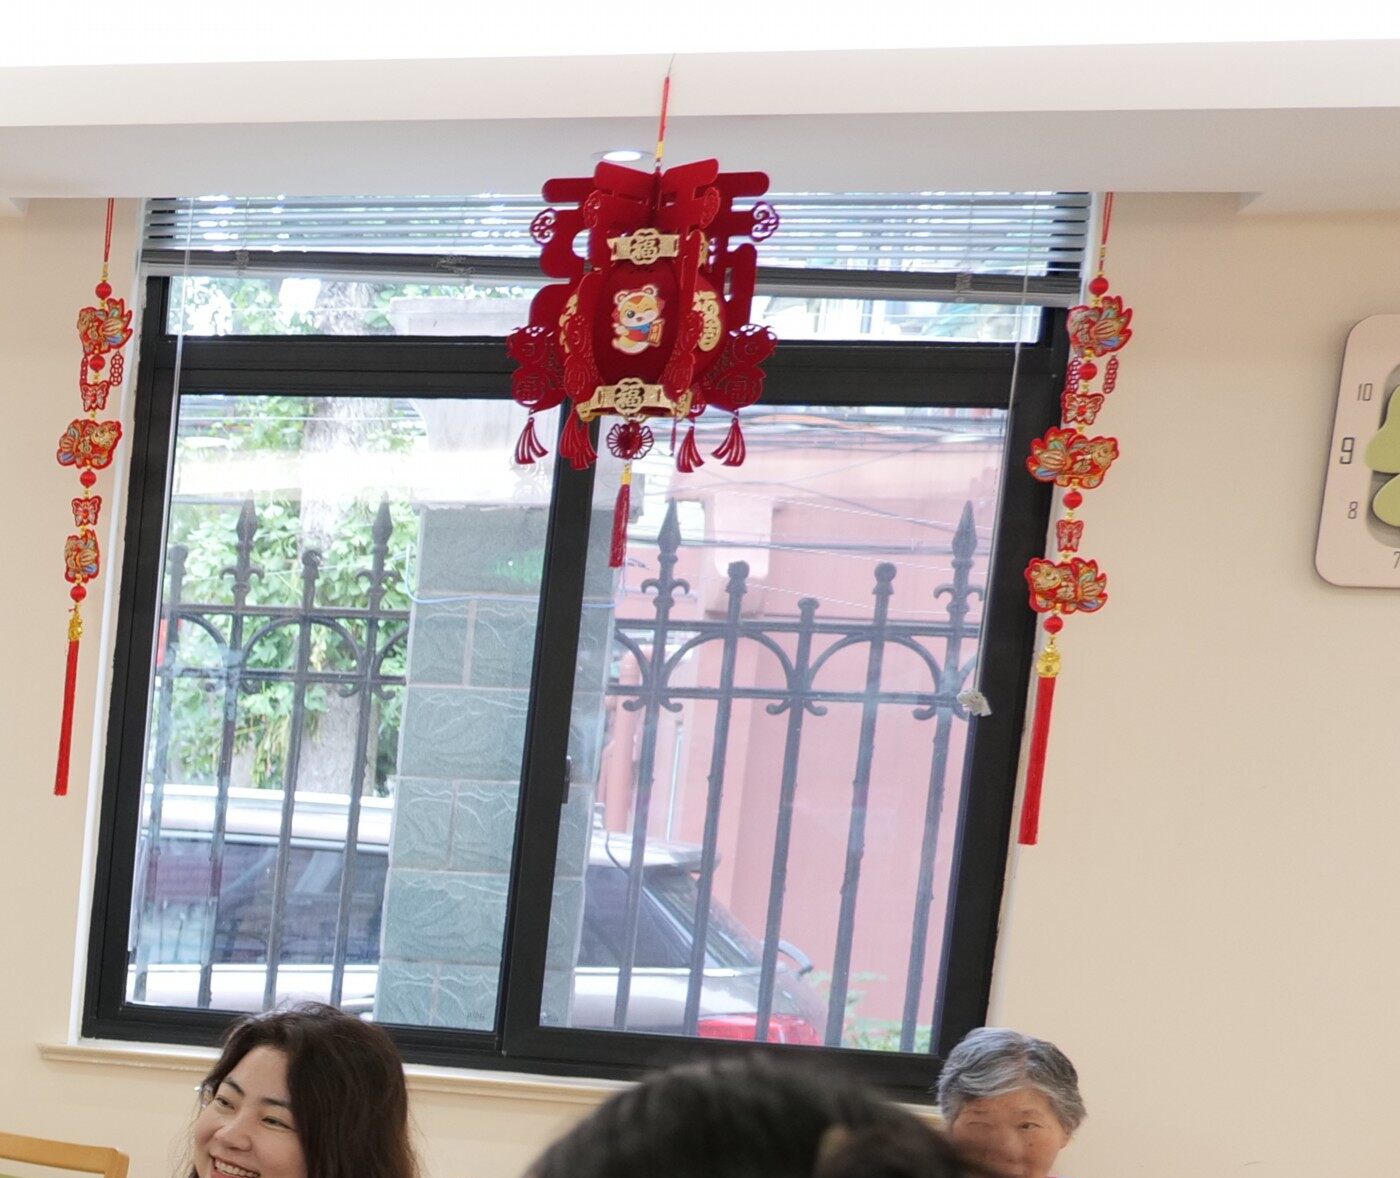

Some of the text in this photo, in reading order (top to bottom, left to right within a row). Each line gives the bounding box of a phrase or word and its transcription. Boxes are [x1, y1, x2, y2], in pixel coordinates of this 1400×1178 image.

[1357, 382, 1373, 402] 10
[1339, 436, 1356, 465] 9
[1347, 500, 1359, 520] 8
